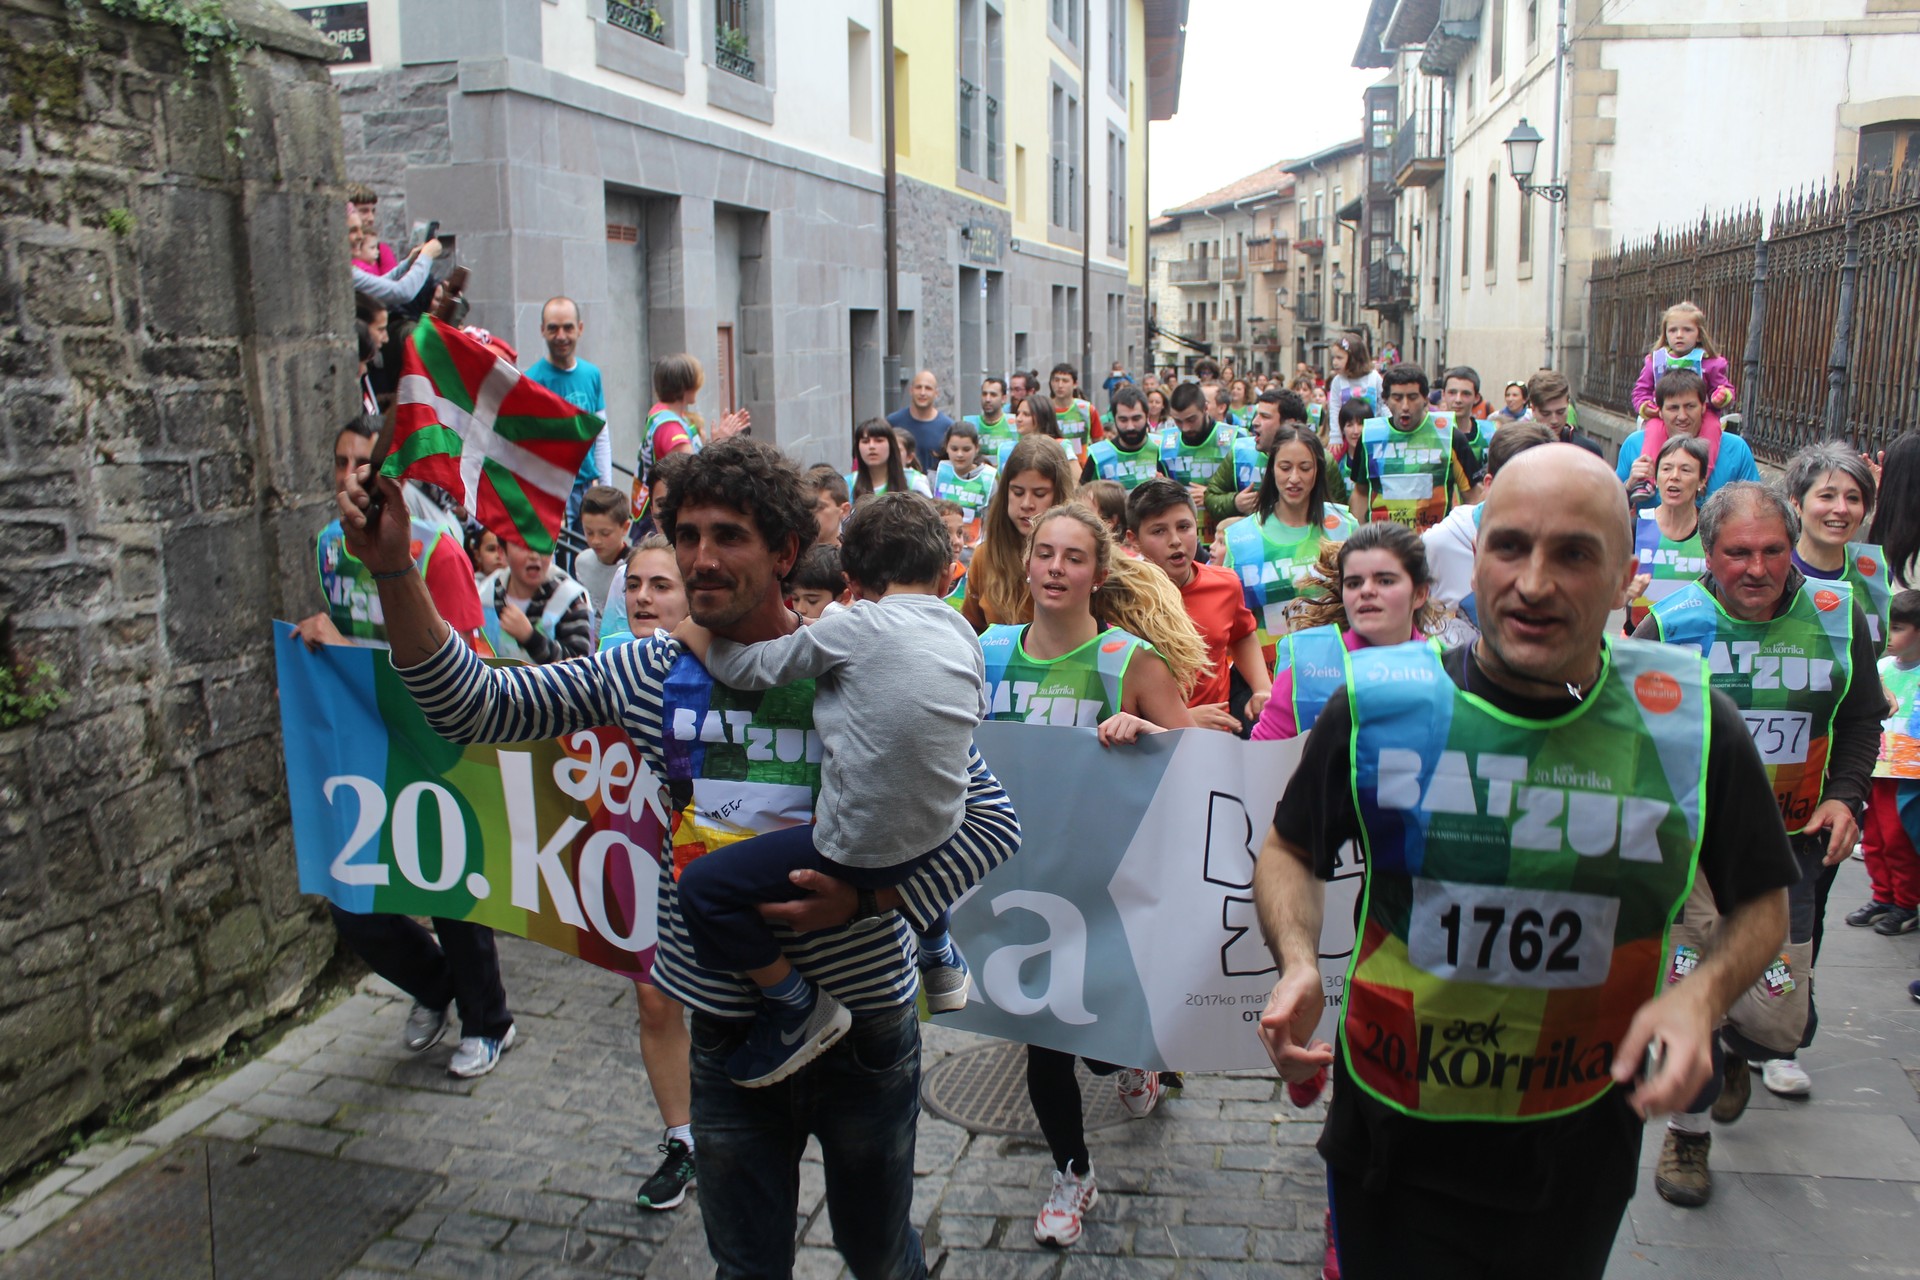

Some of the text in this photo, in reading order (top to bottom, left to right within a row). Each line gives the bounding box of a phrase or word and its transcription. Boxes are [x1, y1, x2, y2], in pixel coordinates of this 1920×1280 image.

[324, 28, 366, 44] ORES
[1241, 557, 1293, 587] BAT
[1640, 548, 1679, 564] BAT
[1773, 644, 1804, 655] korrika
[1317, 668, 1341, 678] eitb
[1752, 656, 1834, 692] ZUK
[673, 708, 753, 744] BAT
[1377, 747, 1528, 816] BAT
[323, 774, 490, 900] 20.
[1510, 785, 1671, 864] ZUK
[1441, 903, 1583, 973] 1762
[1765, 965, 1786, 980] BAT
[1770, 972, 1792, 987] ZUK
[1185, 993, 1236, 1007] 2017ko
[1442, 1012, 1507, 1048] aek
[1416, 1023, 1615, 1093] korrika
